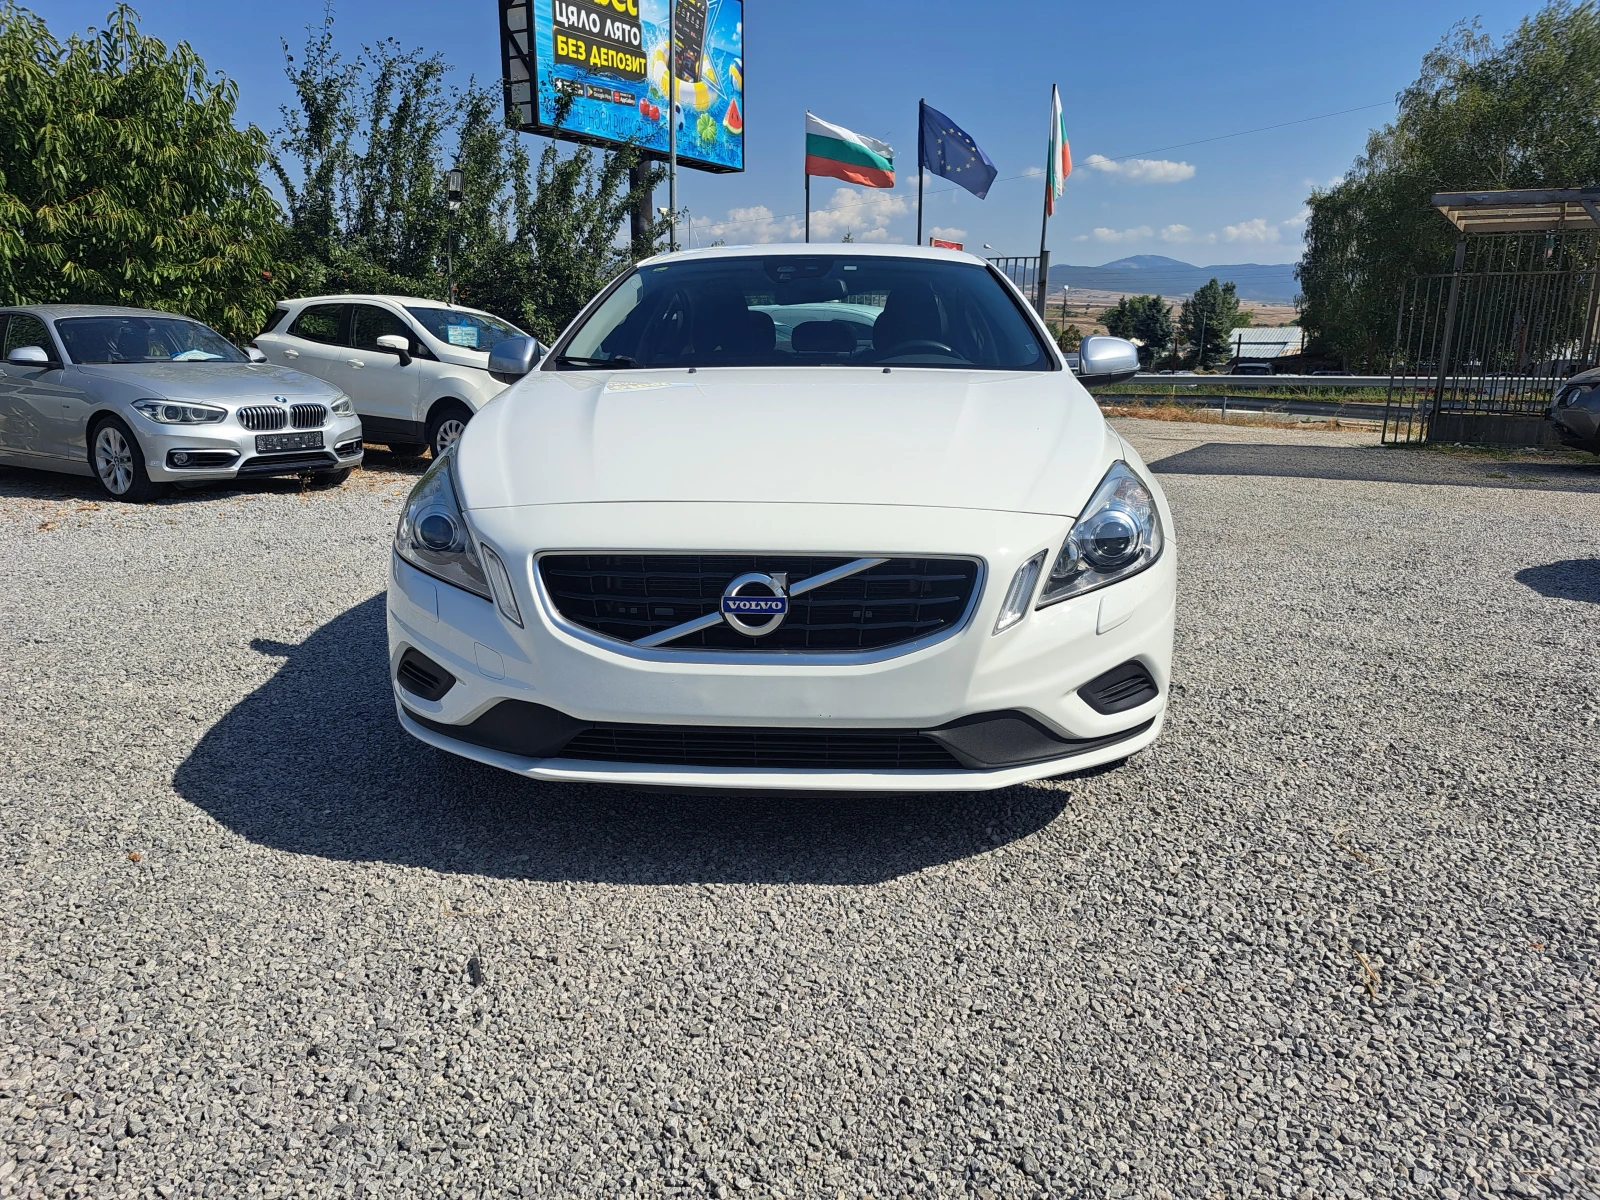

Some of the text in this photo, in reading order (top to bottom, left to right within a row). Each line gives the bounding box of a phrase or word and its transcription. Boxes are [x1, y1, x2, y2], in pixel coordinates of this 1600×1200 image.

[555, 0, 640, 46] ЦЯЛО ЛЯТО
[557, 34, 646, 74] БЕЗ ДЕПОЗИТ
[726, 600, 783, 610] VOLVO
